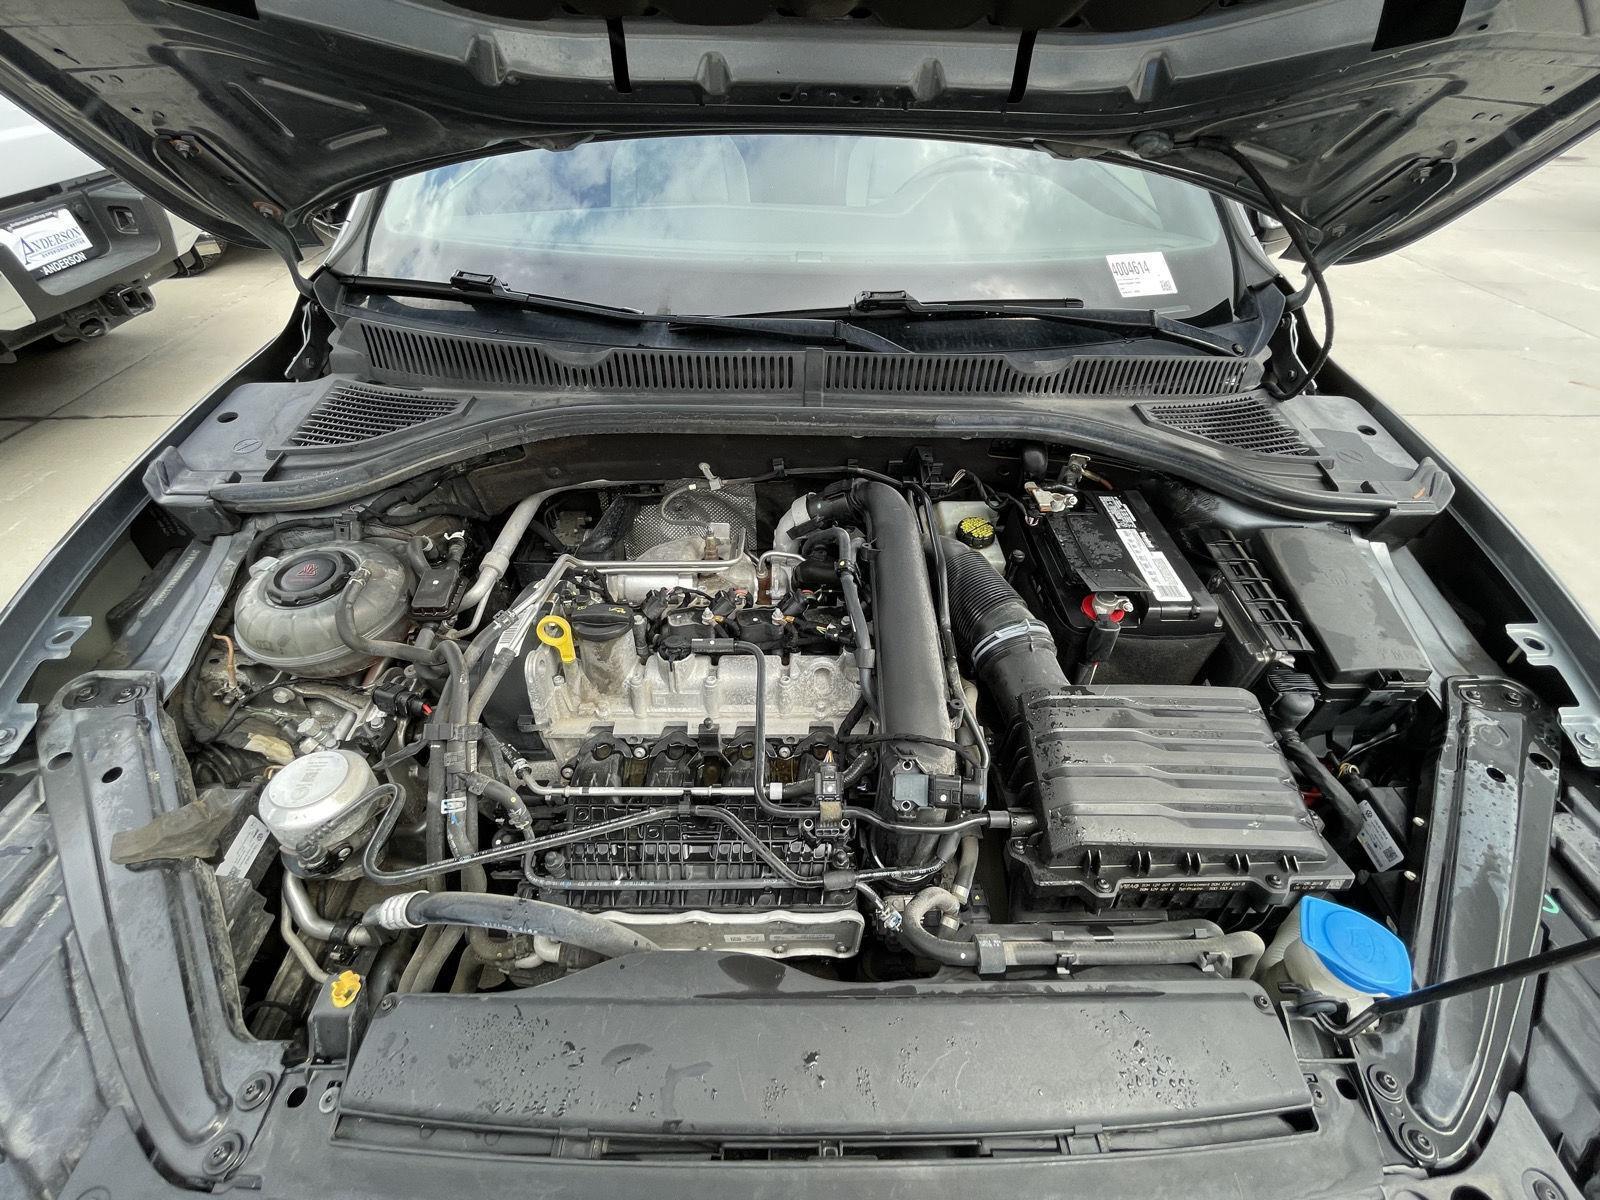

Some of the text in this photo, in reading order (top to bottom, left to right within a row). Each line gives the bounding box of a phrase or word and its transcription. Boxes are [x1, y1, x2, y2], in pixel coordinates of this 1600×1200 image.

[20, 226, 82, 265] ANDERSON
[42, 251, 88, 275] ANDERSON
[1111, 260, 1151, 276] 4004614
